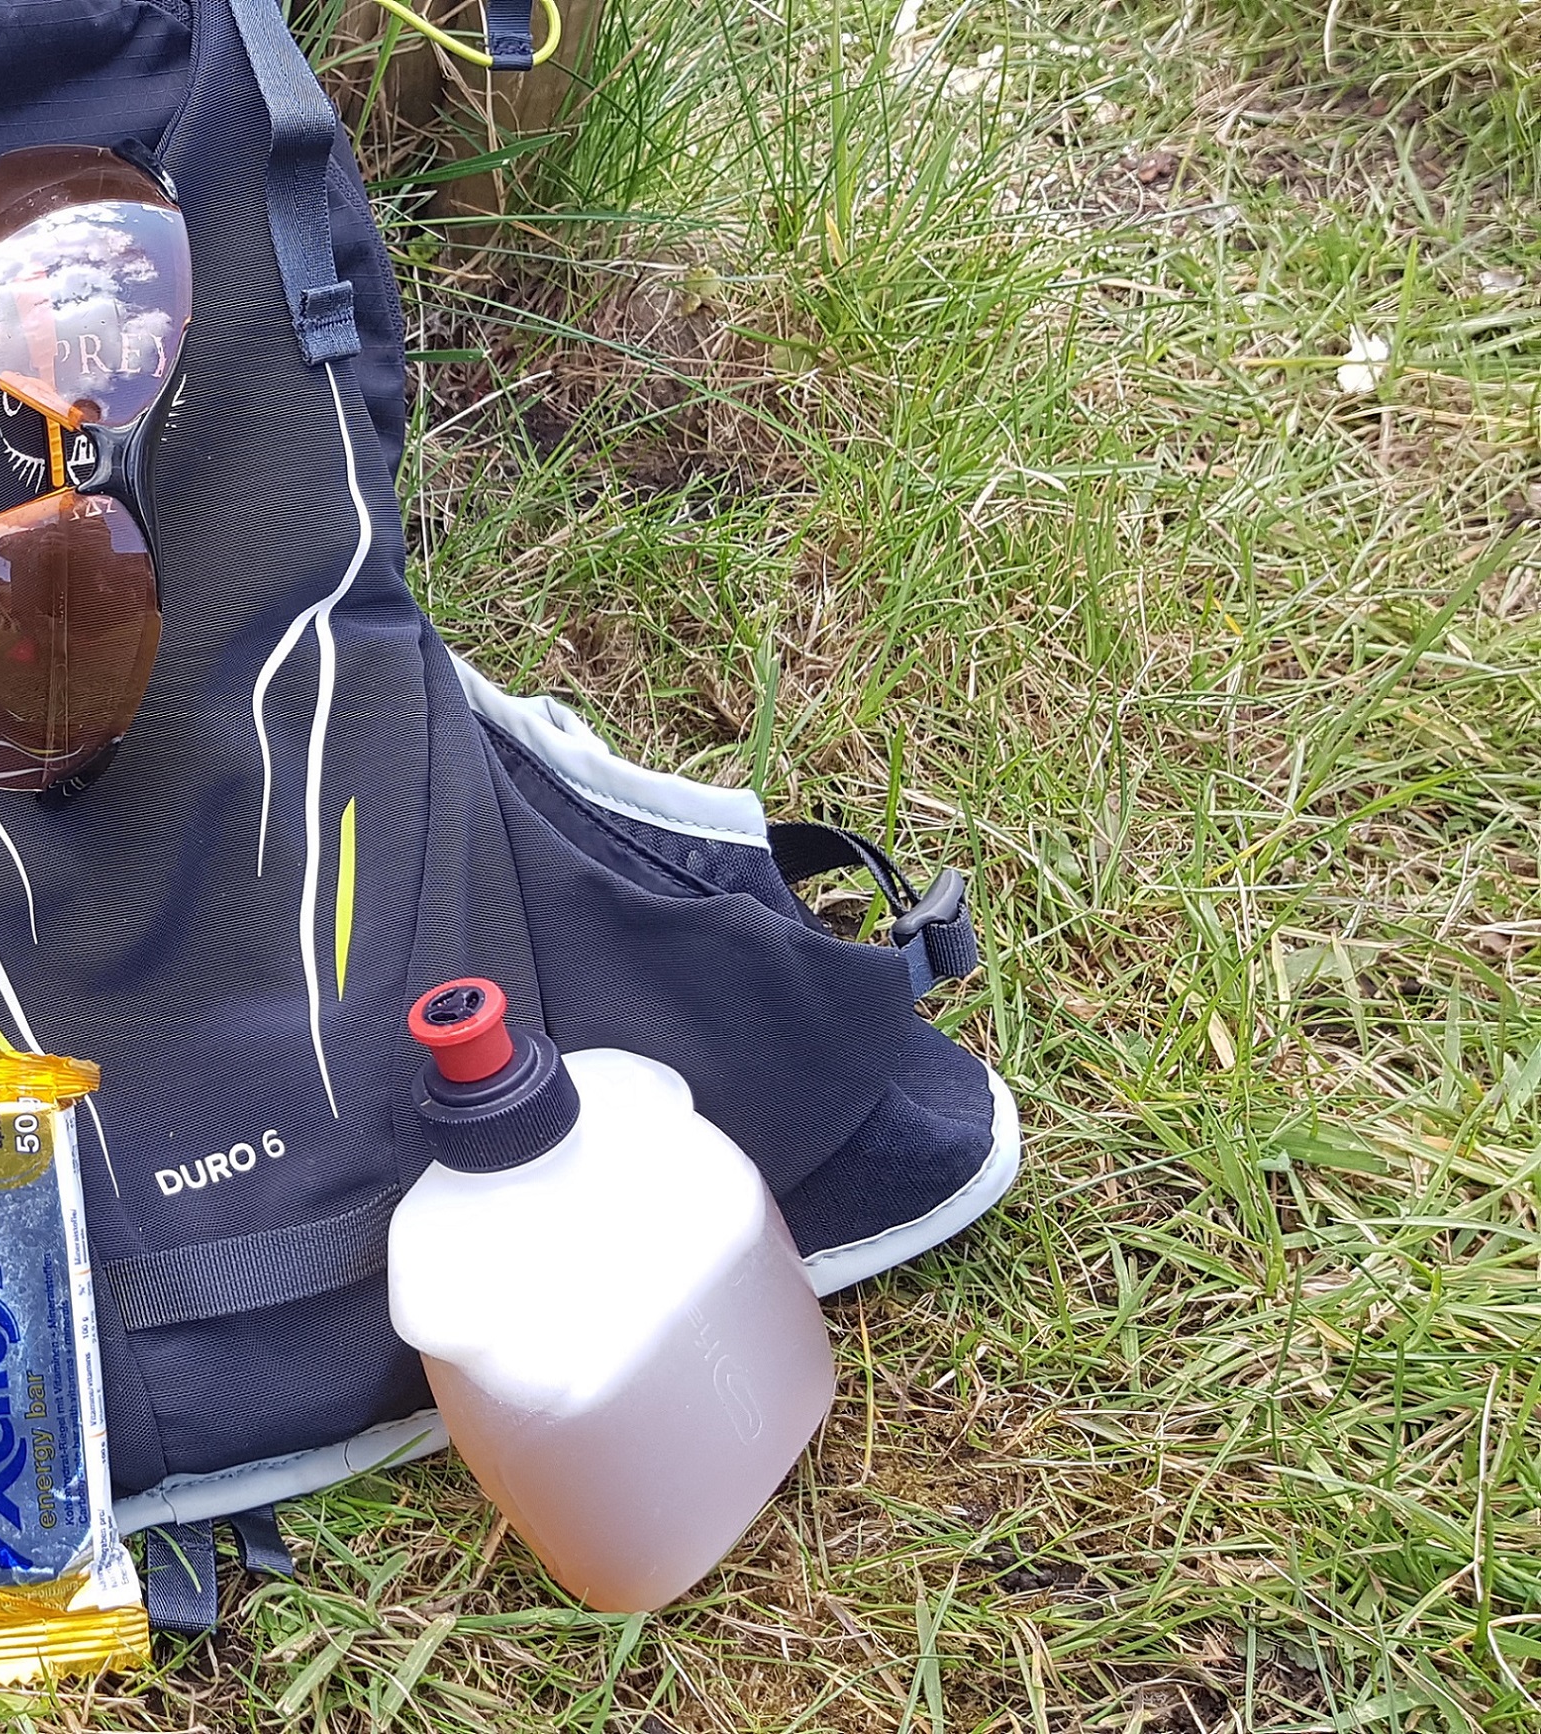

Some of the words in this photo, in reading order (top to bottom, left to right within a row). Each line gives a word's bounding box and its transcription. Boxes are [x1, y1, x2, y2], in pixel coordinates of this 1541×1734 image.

[154, 1142, 256, 1195] DURO
[262, 1128, 285, 1158] 6
[43, 1252, 57, 1329] Mineralstoffen
[51, 1341, 62, 1395] Vitaminen
[66, 1359, 77, 1404] vitamins
[25, 1369, 47, 1420] bar
[56, 1396, 64, 1414] mit
[72, 1430, 81, 1449] bar
[31, 1427, 57, 1529] energy
